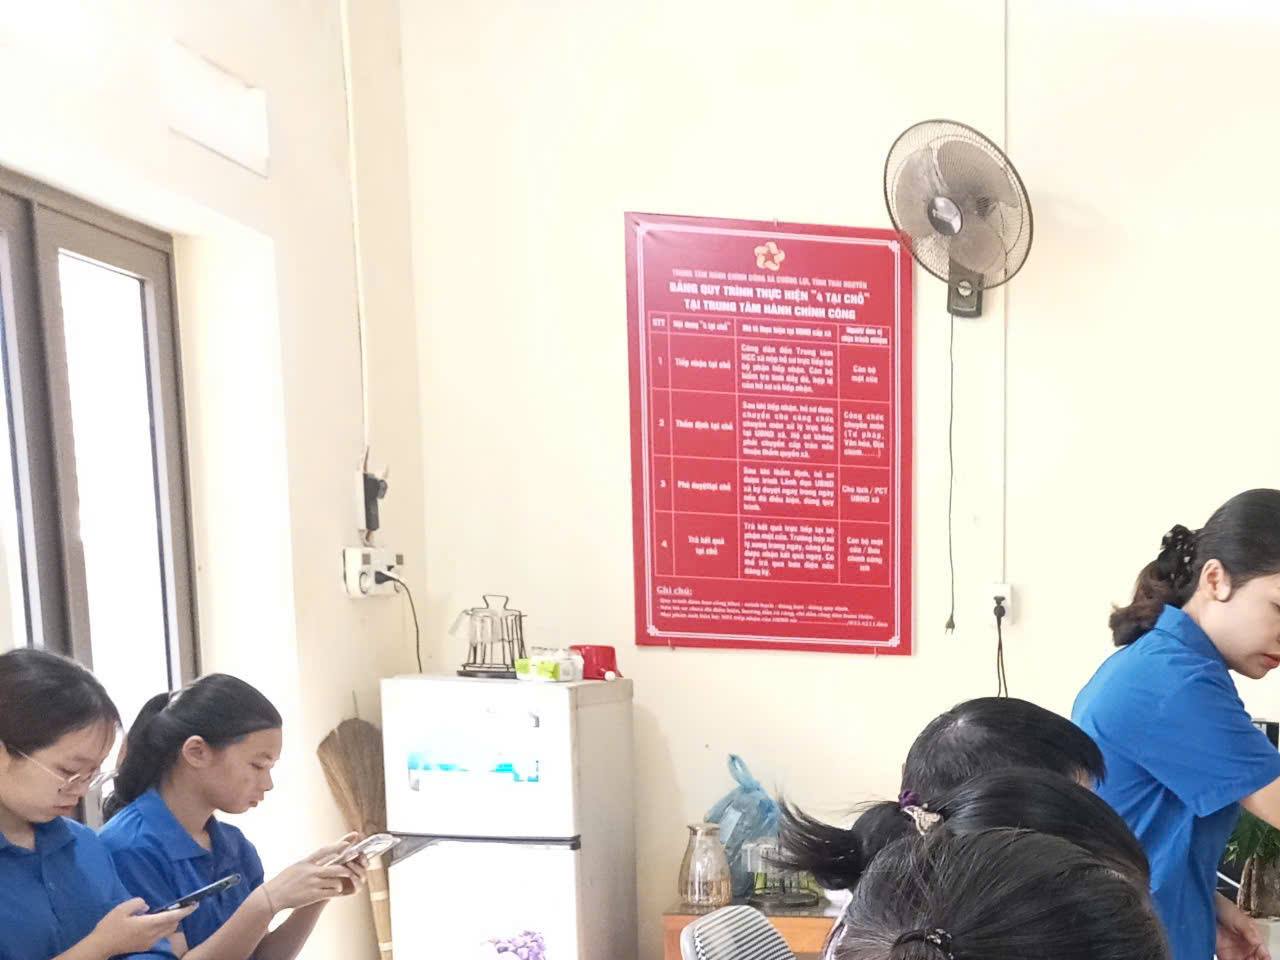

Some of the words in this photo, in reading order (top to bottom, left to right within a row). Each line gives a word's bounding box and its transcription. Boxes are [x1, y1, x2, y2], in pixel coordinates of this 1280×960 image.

[670, 280, 698, 294] BẢNG
[700, 284, 720, 296] QUY
[723, 285, 753, 297] TRÌNH
[756, 288, 782, 300] THỰC
[784, 287, 808, 302] HIỆN
[826, 292, 841, 305] TẠI
[684, 299, 700, 312] TẠI
[703, 300, 736, 312] TRUNG
[739, 300, 761, 313] TÂM
[764, 302, 792, 315] HÀNH
[794, 304, 825, 318] CHÍNH
[828, 306, 856, 320] CÔNG
